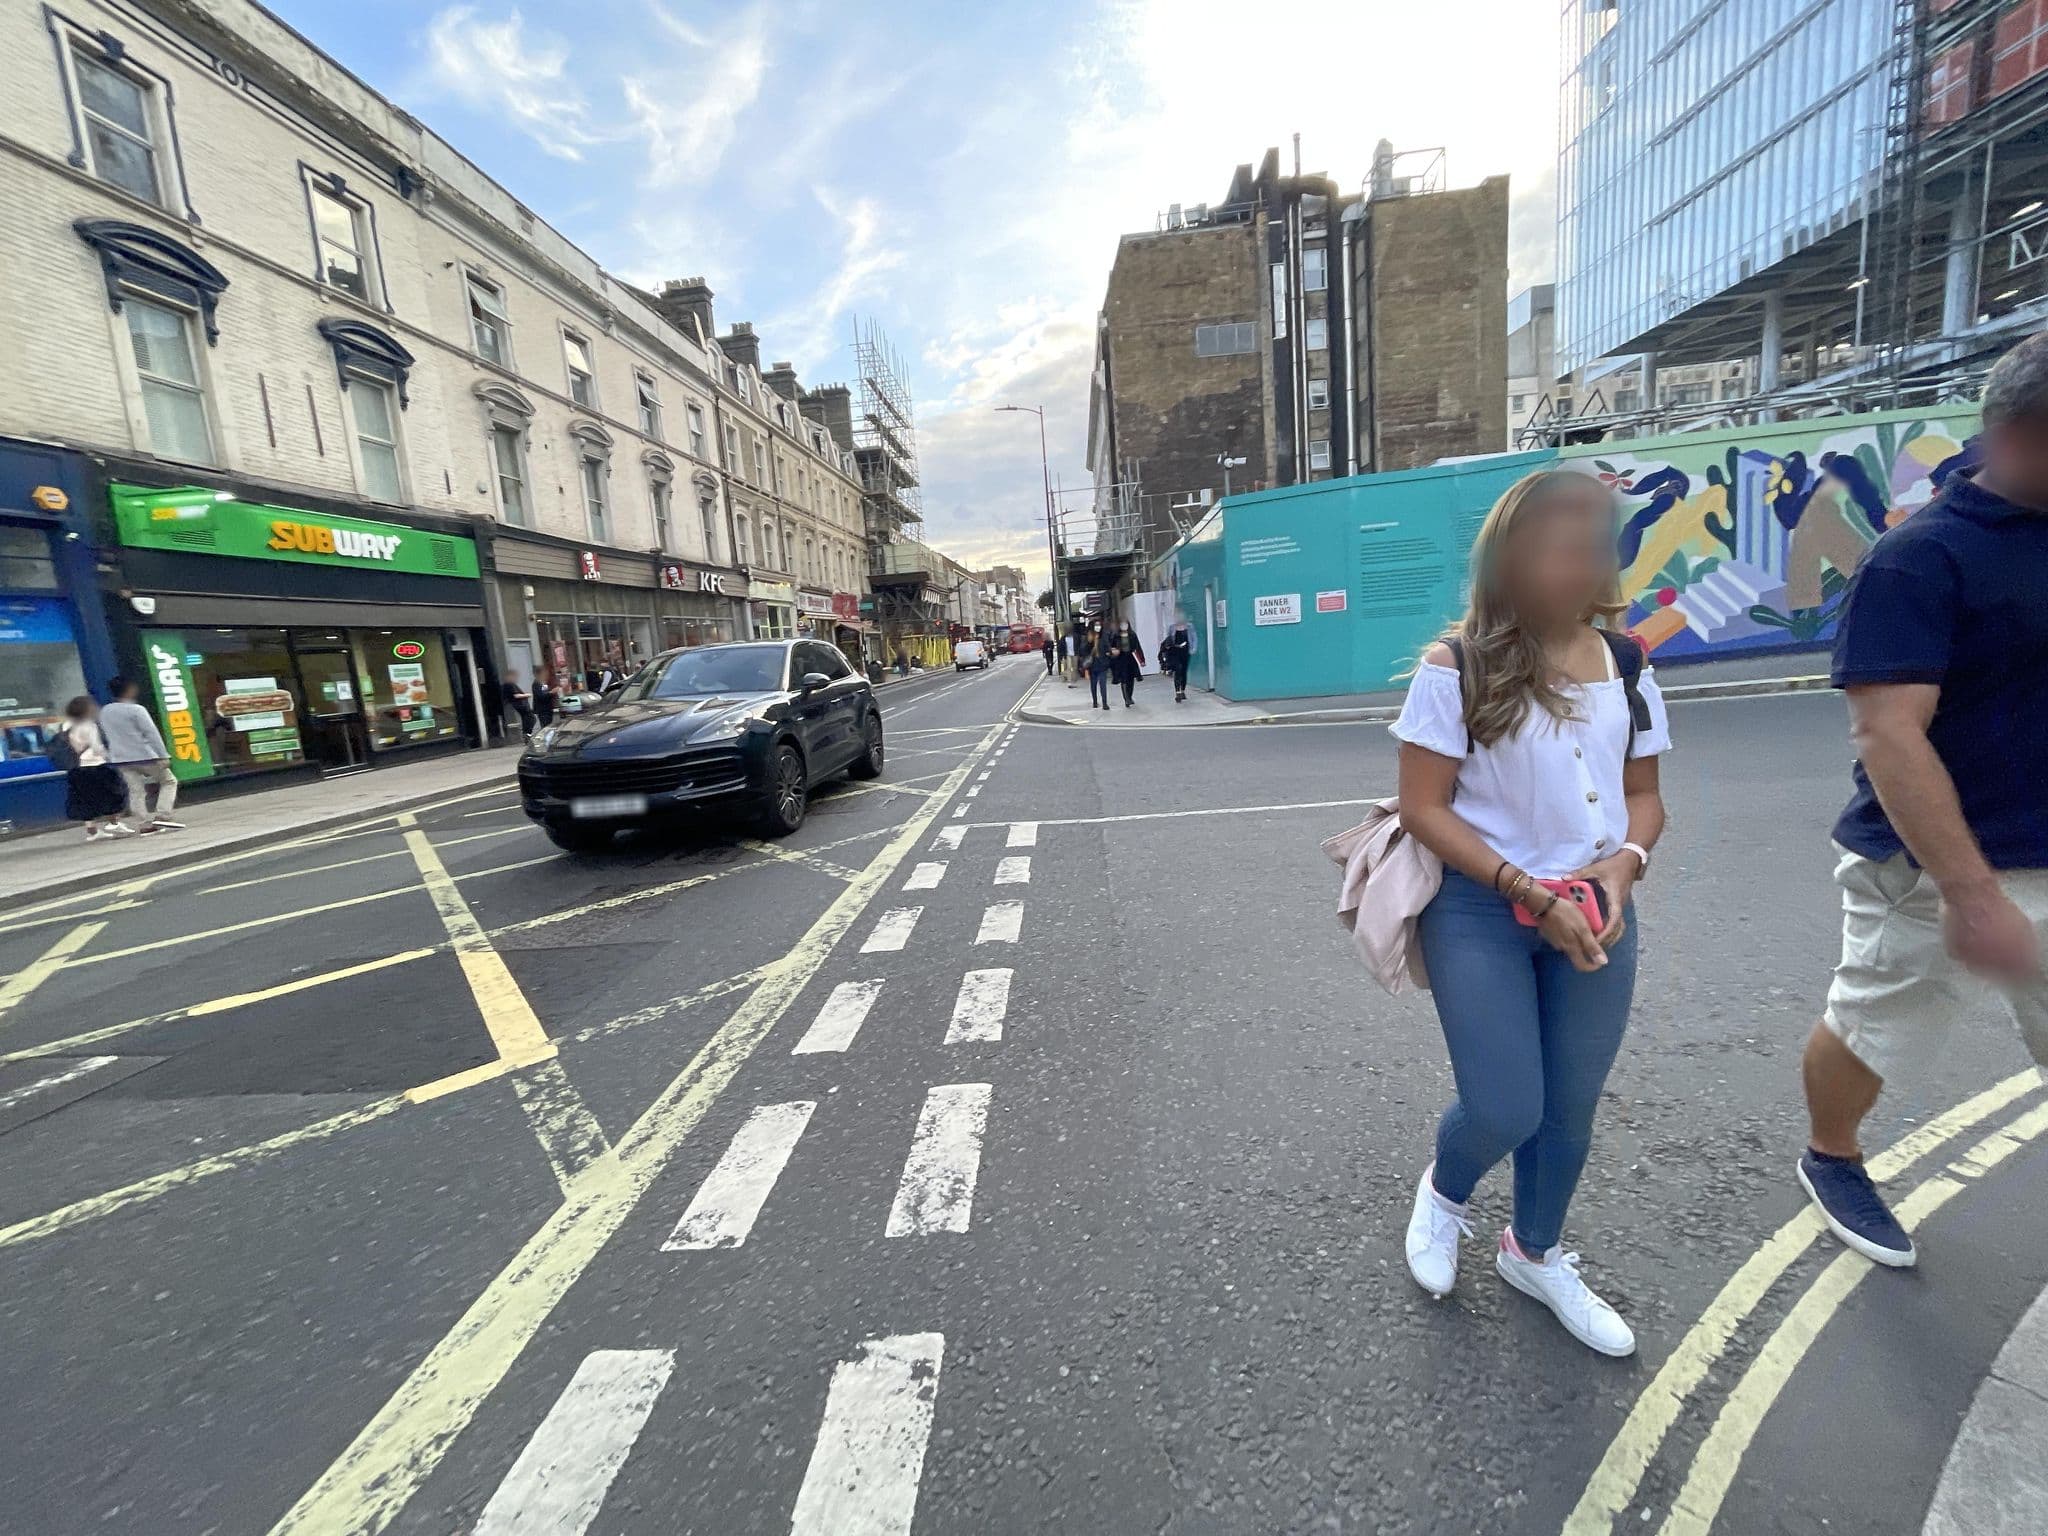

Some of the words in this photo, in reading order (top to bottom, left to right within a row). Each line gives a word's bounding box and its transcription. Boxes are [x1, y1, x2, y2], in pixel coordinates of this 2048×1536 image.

[267, 521, 402, 561] SUBWAY
[700, 571, 726, 593] KFC
[1259, 598, 1289, 607] TANNER
[1259, 607, 1278, 616] LANE
[1279, 606, 1292, 614] W2
[151, 644, 201, 762] SUBWAY
